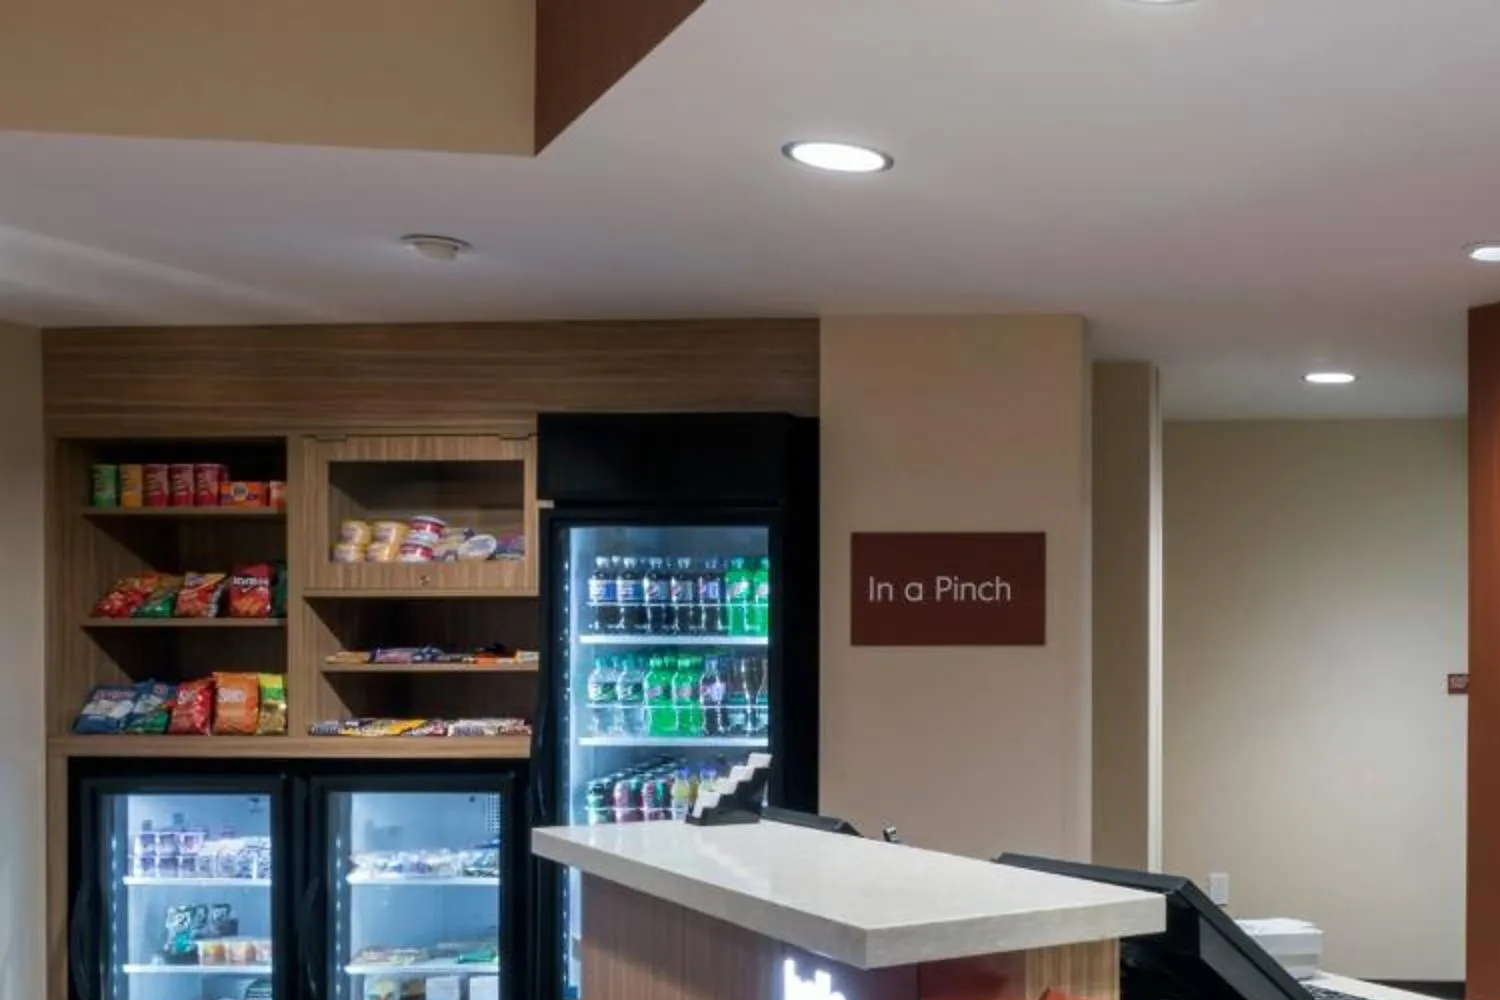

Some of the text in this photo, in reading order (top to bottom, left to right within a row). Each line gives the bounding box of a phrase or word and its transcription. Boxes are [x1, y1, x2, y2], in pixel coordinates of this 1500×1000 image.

[869, 575, 1012, 602] In a Pinch
